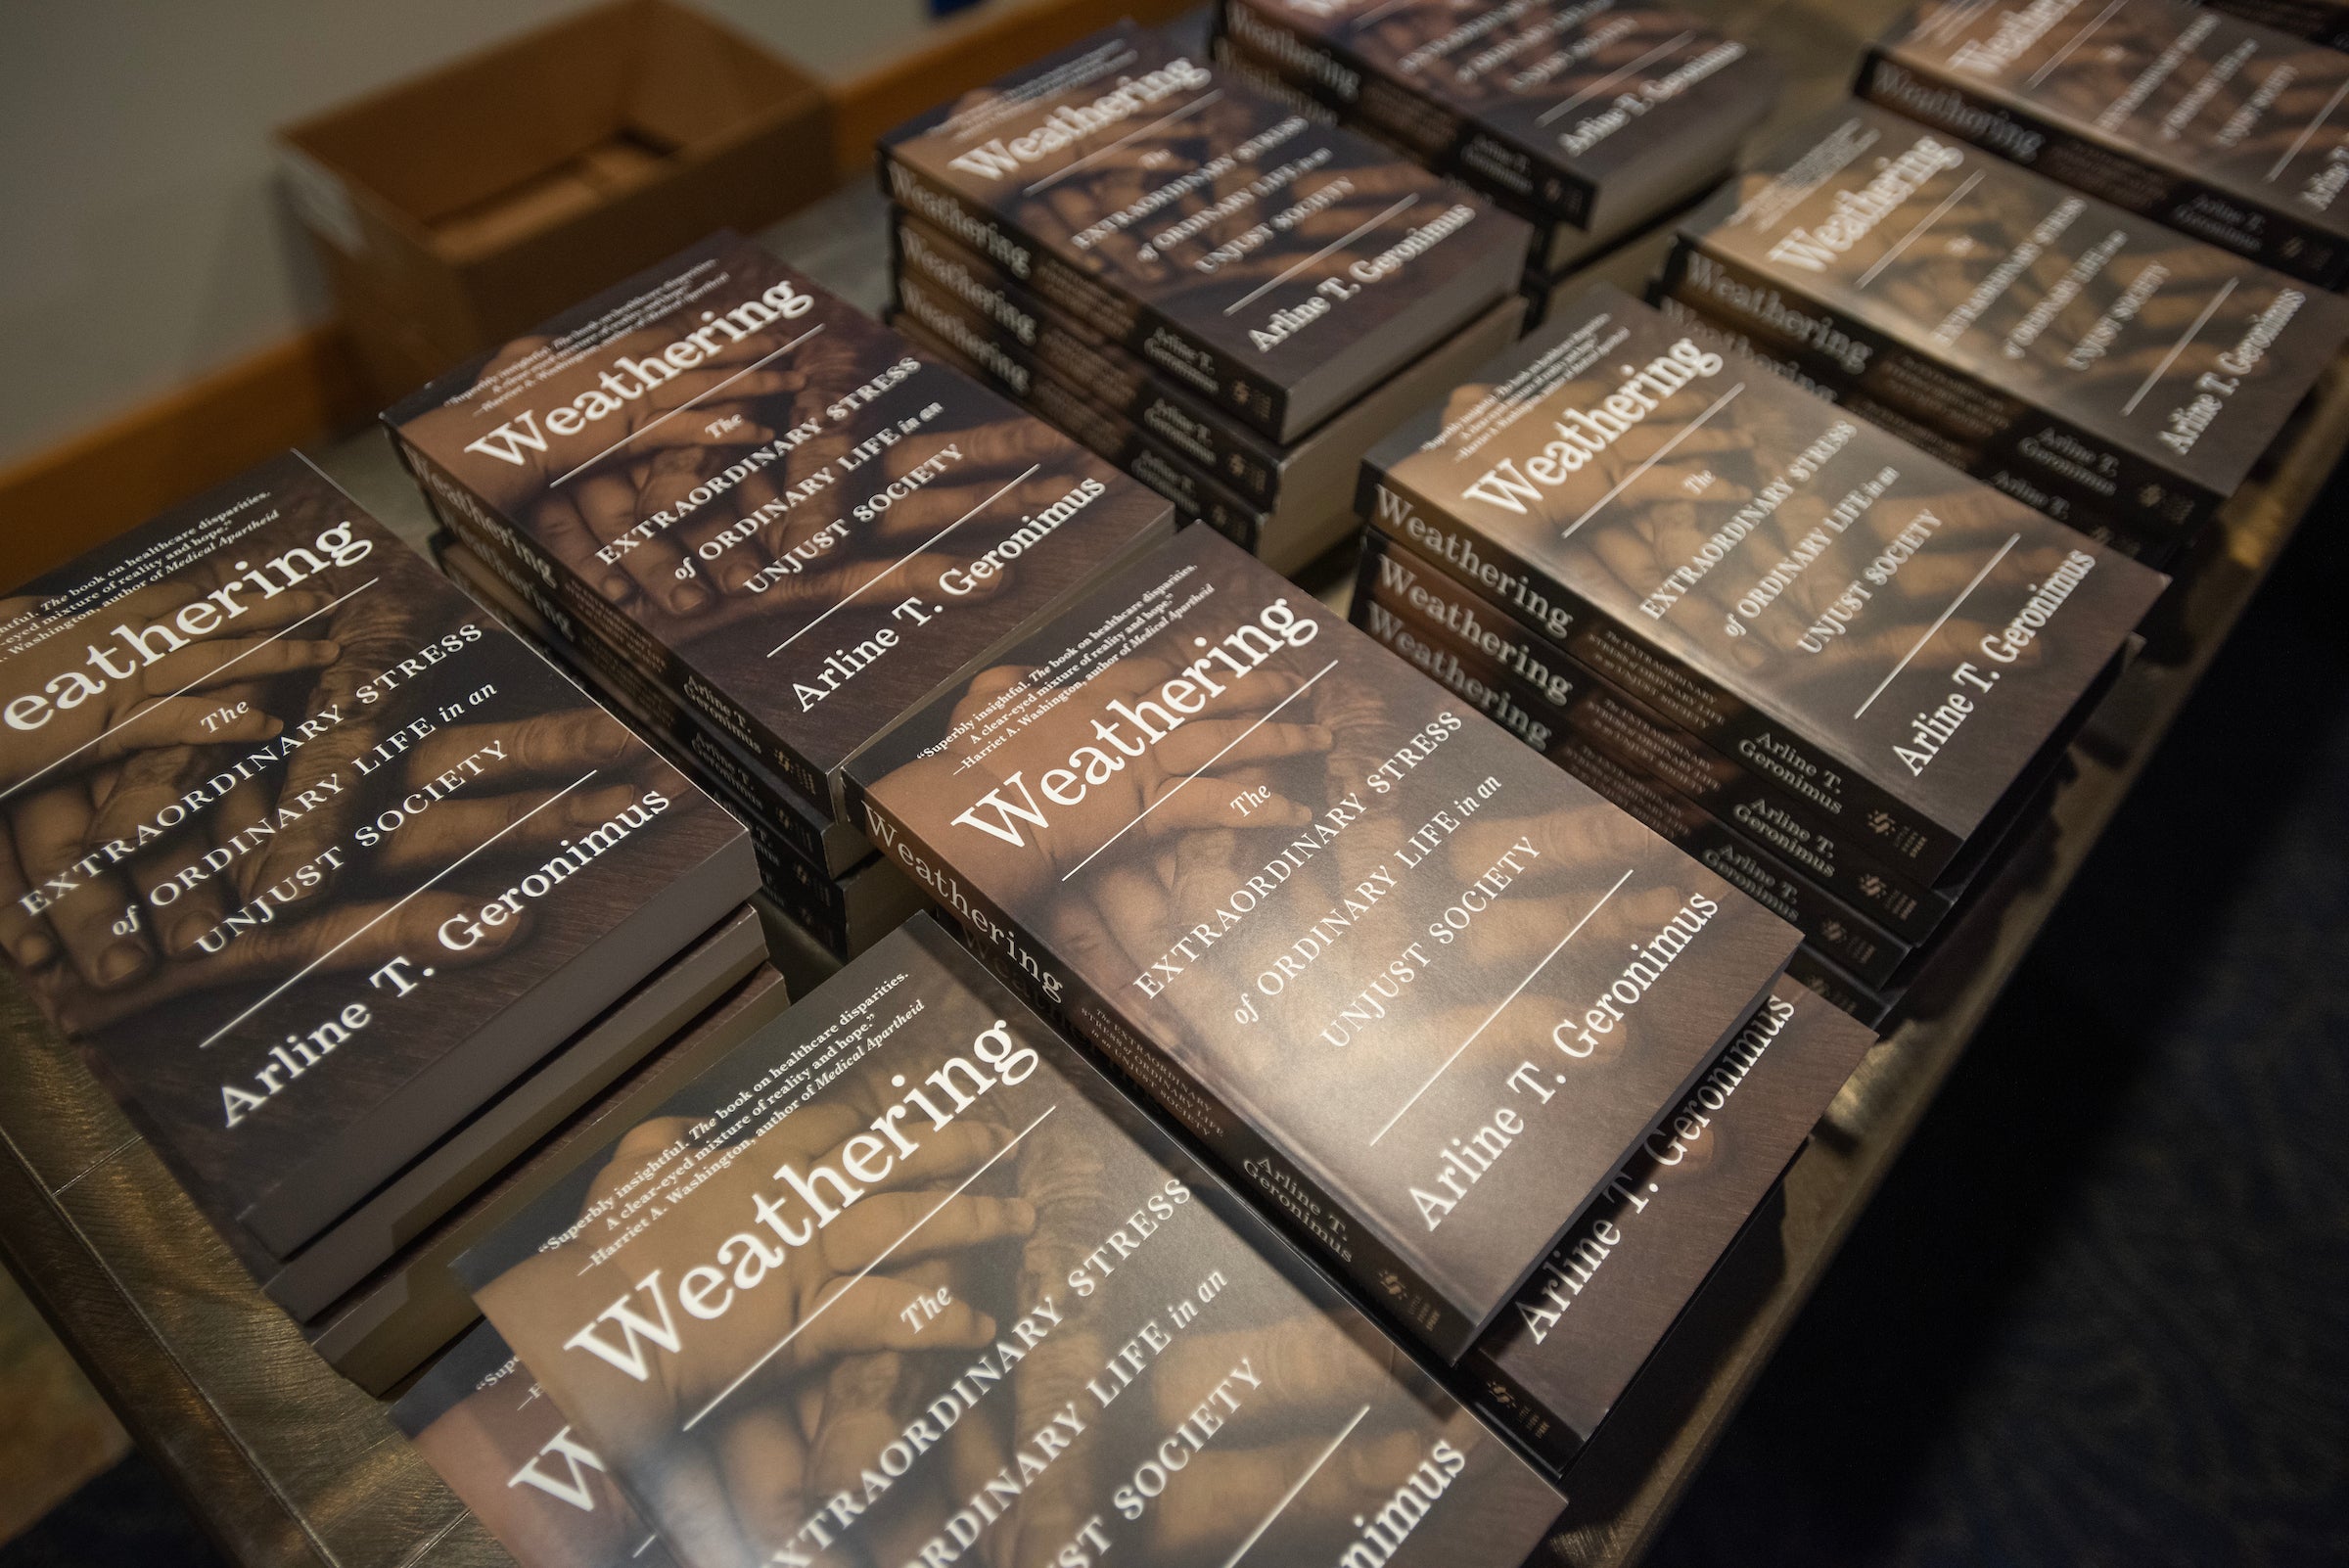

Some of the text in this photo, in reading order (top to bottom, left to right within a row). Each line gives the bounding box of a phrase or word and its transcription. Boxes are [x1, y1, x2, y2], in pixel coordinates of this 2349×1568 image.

[945, 54, 1214, 180] Weathering
[1245, 202, 1478, 354] Arline T. Geronimus
[462, 280, 814, 466] Weathering
[704, 414, 744, 439] The
[1460, 337, 1725, 515] Weathering
[593, 417, 824, 566] EXTRAORDINARY
[826, 358, 922, 420] STRESS
[673, 402, 944, 580] of ORDINARY LIFE in an
[741, 443, 965, 593] UNJUST SOCIETY
[1637, 475, 1796, 620] EXTRAORDINARY
[1787, 420, 1858, 481] STRESS
[1681, 470, 1717, 496] The
[1821, 489, 1874, 533] LIFE
[8, 607, 103, 655] Washington,
[102, 579, 149, 608] author
[149, 569, 164, 582] of
[163, 540, 217, 576] Medical
[217, 507, 280, 548] Apartheid
[42, 591, 102, 625] mixture
[102, 579, 118, 594] of
[117, 557, 164, 586] reality
[189, 519, 234, 546] hope.”
[68, 575, 108, 597] book
[124, 528, 198, 568] healthcare
[198, 490, 272, 530] disparities.
[790, 479, 1106, 712] Arline T. Geronimus
[1377, 484, 1574, 639] Weathering
[1735, 527, 1834, 619] ORDINARY
[1794, 579, 1874, 654] UNJUST
[1863, 508, 1943, 585] SOCIETY
[4, 520, 374, 730] eathering
[915, 719, 975, 760] “Superbly
[971, 680, 1032, 722] insightful.
[1047, 646, 1080, 669] book
[1087, 600, 1144, 640] healthcare
[1141, 564, 1199, 604] disparities.
[952, 582, 1216, 776] —Harriet A. Washington, author of Medical Apartheid
[969, 734, 983, 745] A
[981, 692, 1038, 737] clear-eyed
[1036, 664, 1081, 697] mixture
[1079, 652, 1093, 667] of
[1089, 630, 1128, 659] reality
[1139, 592, 1174, 621] hope.”
[1369, 600, 1552, 753] Weathering
[1378, 553, 1574, 706] Weathering
[1723, 612, 1748, 638] of
[1891, 692, 1975, 777] Arline
[1950, 662, 2001, 695] T.
[1979, 548, 2095, 664] Geronimus
[15, 704, 345, 916] EXTRAORDINARY
[355, 623, 483, 706] STRESS
[200, 701, 251, 734] The
[949, 597, 1319, 849] Weathering
[1738, 738, 1843, 814] Geronimus
[1756, 732, 1842, 795] Arline T.
[111, 682, 498, 936] of ORDINARY LIFE in an
[192, 739, 508, 953] UNJUST SOCIETY
[1131, 791, 1367, 1000] EXTRAORDINARY
[1366, 711, 1462, 794] STRESS
[1228, 784, 1272, 818] The
[219, 785, 670, 1129] Arline T. Geronimus
[861, 800, 1064, 1004] Weathering
[1233, 775, 1502, 1026] of ORDINARY LIFE in an
[1317, 835, 1541, 1047] UNJUST SOCIETY
[538, 1194, 616, 1254] “Superbly
[614, 1137, 692, 1199] insightful.
[714, 1089, 756, 1120] book
[767, 1022, 840, 1080] healthcare
[839, 971, 911, 1027] disparities.
[576, 995, 927, 1277] —Harriet A. Washington, author of Medical Apartheid
[606, 1216, 622, 1231] A
[621, 1154, 697, 1220] clear-eyed
[694, 1114, 753, 1162] mixture
[751, 1096, 769, 1118] of
[766, 1065, 813, 1106] reality
[833, 1010, 878, 1050] hope.”
[1081, 1007, 1123, 1047] STRESS
[1134, 1054, 1193, 1108] ORDINARY
[1114, 1024, 1213, 1112] EXTRAORDINARY
[1114, 1048, 1212, 1136] UNJUST SOCIETY
[1407, 1107, 1525, 1232] Arline
[1505, 1060, 1567, 1105] T.
[1552, 892, 1719, 1059] Geronimus
[562, 1016, 1041, 1382] Weathering
[1243, 1159, 1353, 1263] Geronimus
[1258, 1158, 1349, 1242] Arline T.
[1514, 992, 1795, 1346] Arline T. Geronimus
[476, 1356, 521, 1392] “Supe
[760, 1293, 1064, 1568] XTRAORDINARY
[1067, 1176, 1191, 1297] STRESS
[899, 1285, 953, 1334] The
[901, 1400, 1087, 1568] RDINARY
[1084, 1319, 1173, 1408] LIFE
[1166, 1299, 1200, 1329] in
[1196, 1268, 1228, 1304] an
[1113, 1356, 1263, 1520] SOCIETY
[1339, 1437, 1466, 1568] nimus
